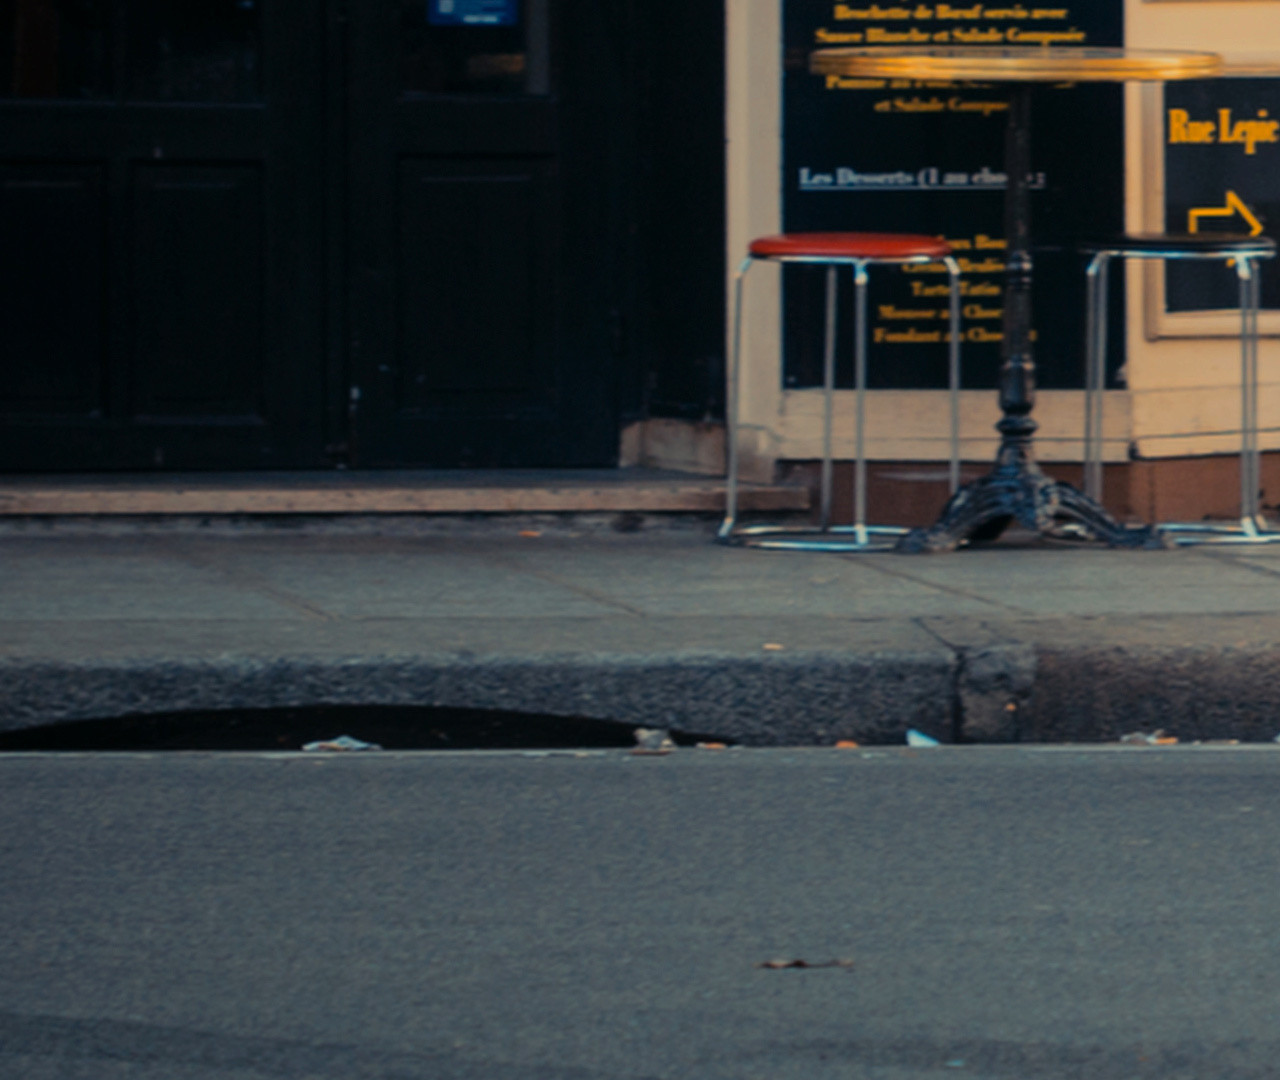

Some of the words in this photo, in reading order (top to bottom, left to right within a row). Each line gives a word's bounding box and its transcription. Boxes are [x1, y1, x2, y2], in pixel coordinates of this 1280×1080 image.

[1168, 108, 1216, 143] Rue
[1218, 108, 1280, 154] Lepic
[799, 167, 833, 184] Les
[836, 167, 914, 184] Desserts
